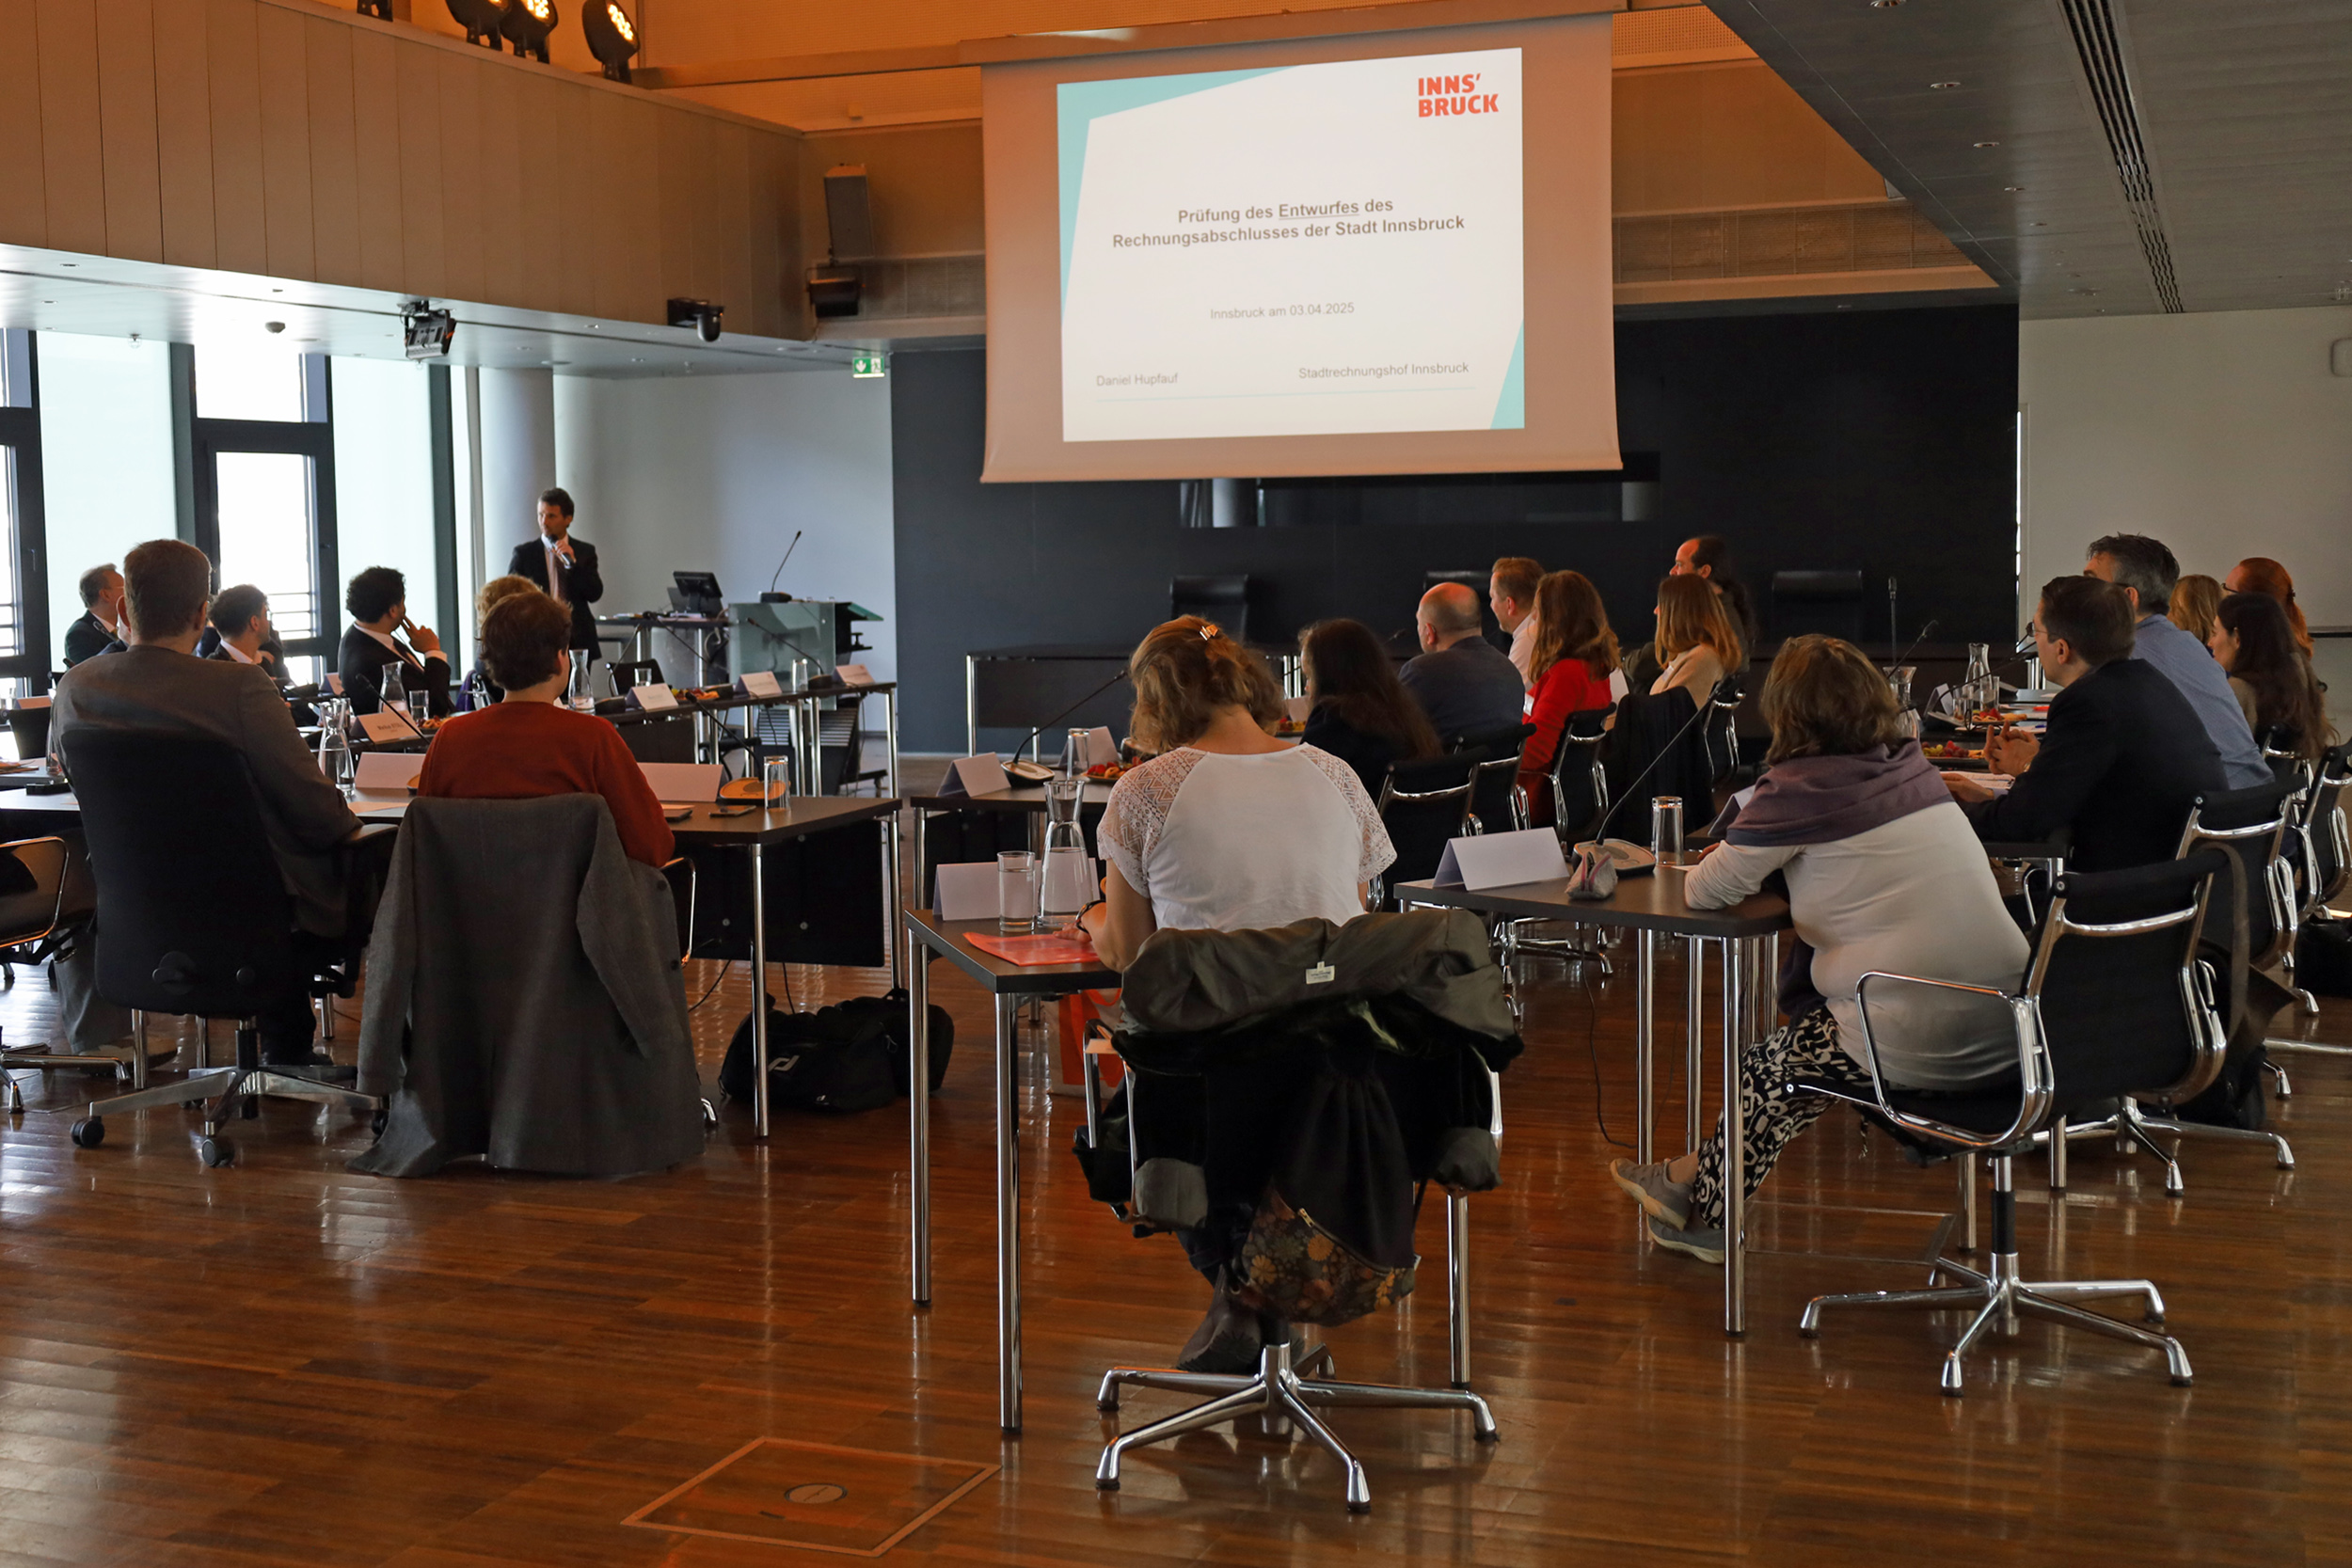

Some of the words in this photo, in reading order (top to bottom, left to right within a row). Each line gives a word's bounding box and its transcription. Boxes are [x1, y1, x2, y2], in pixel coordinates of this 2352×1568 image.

[1418, 72, 1481, 96] INNS'
[1418, 93, 1499, 118] BRUCK
[1178, 208, 1241, 224] Prüfung
[1245, 205, 1274, 220] des
[1279, 199, 1359, 218] Entwurfes
[1364, 198, 1394, 213] des
[1112, 227, 1299, 248] Rechnungsabschlusses
[1304, 223, 1331, 238] der
[1335, 219, 1378, 236] Stadt
[1382, 214, 1465, 233] Innsbruck
[1210, 307, 1265, 320] Innsbruck
[1267, 308, 1287, 318] am
[1289, 301, 1355, 316] 03.04.2025
[1095, 374, 1132, 388] Daniel
[1134, 372, 1179, 387] Hupfauf
[1298, 363, 1408, 380] Stadtrechnungshof
[1411, 361, 1470, 375] Innsbruck
